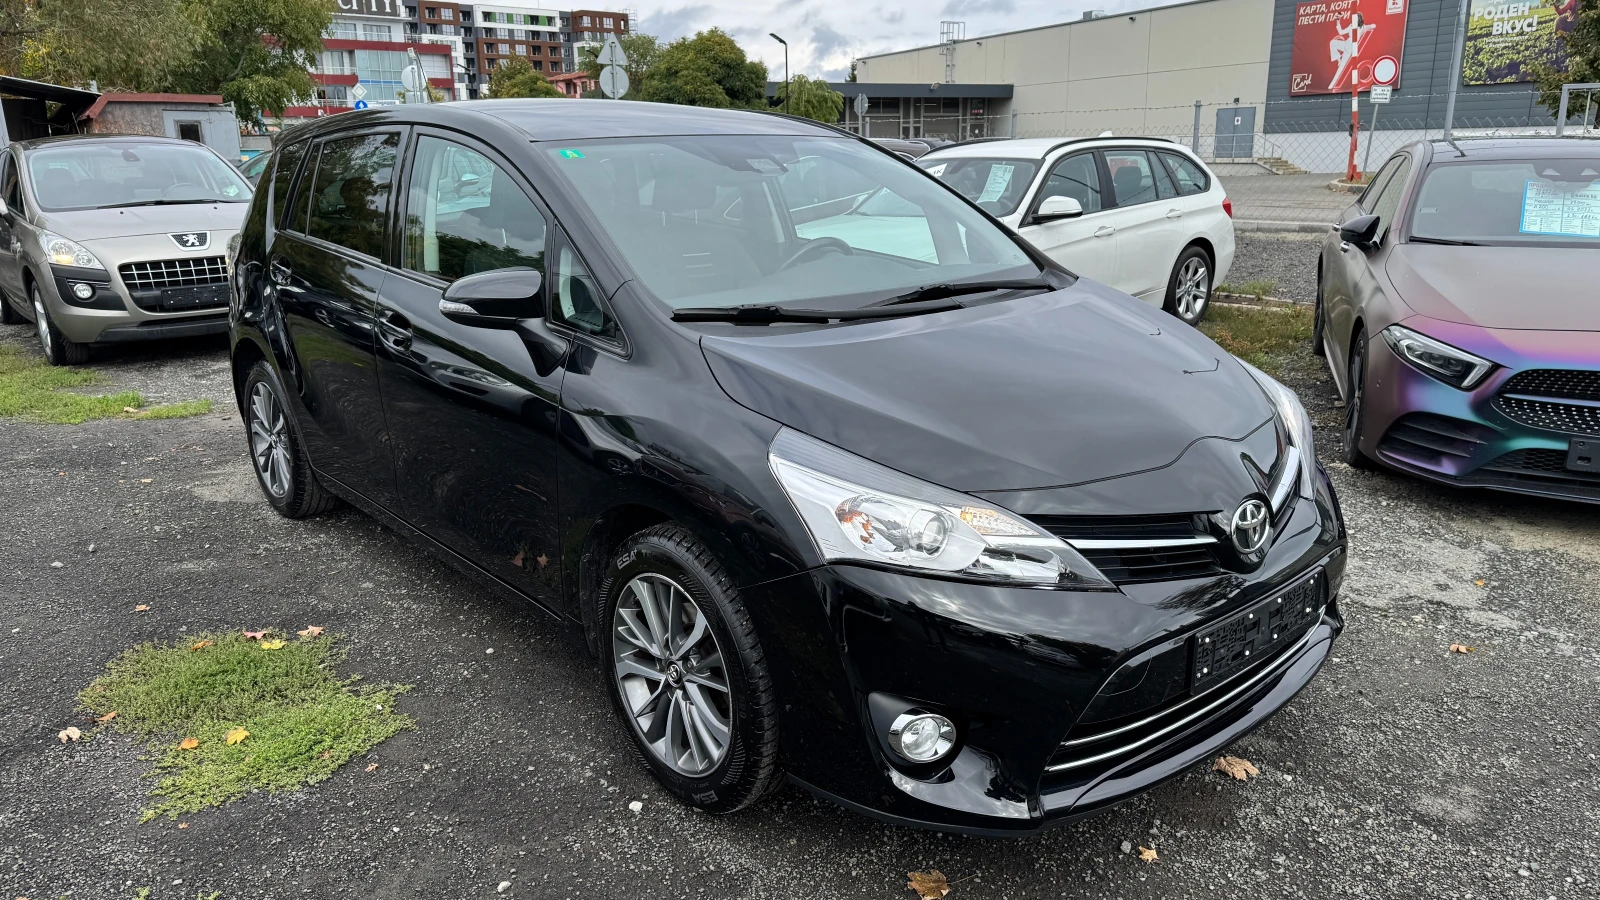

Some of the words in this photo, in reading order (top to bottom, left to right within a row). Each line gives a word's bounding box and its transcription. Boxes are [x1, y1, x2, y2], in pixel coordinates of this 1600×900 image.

[1299, 4, 1328, 15] КАРТА,
[1330, 0, 1360, 11] КОЯТ
[1474, 2, 1530, 21] РОДЕН
[1298, 14, 1325, 25] ПЕСТИ
[1492, 14, 1538, 36] ВКУС!
[1294, 74, 1312, 90] Card
